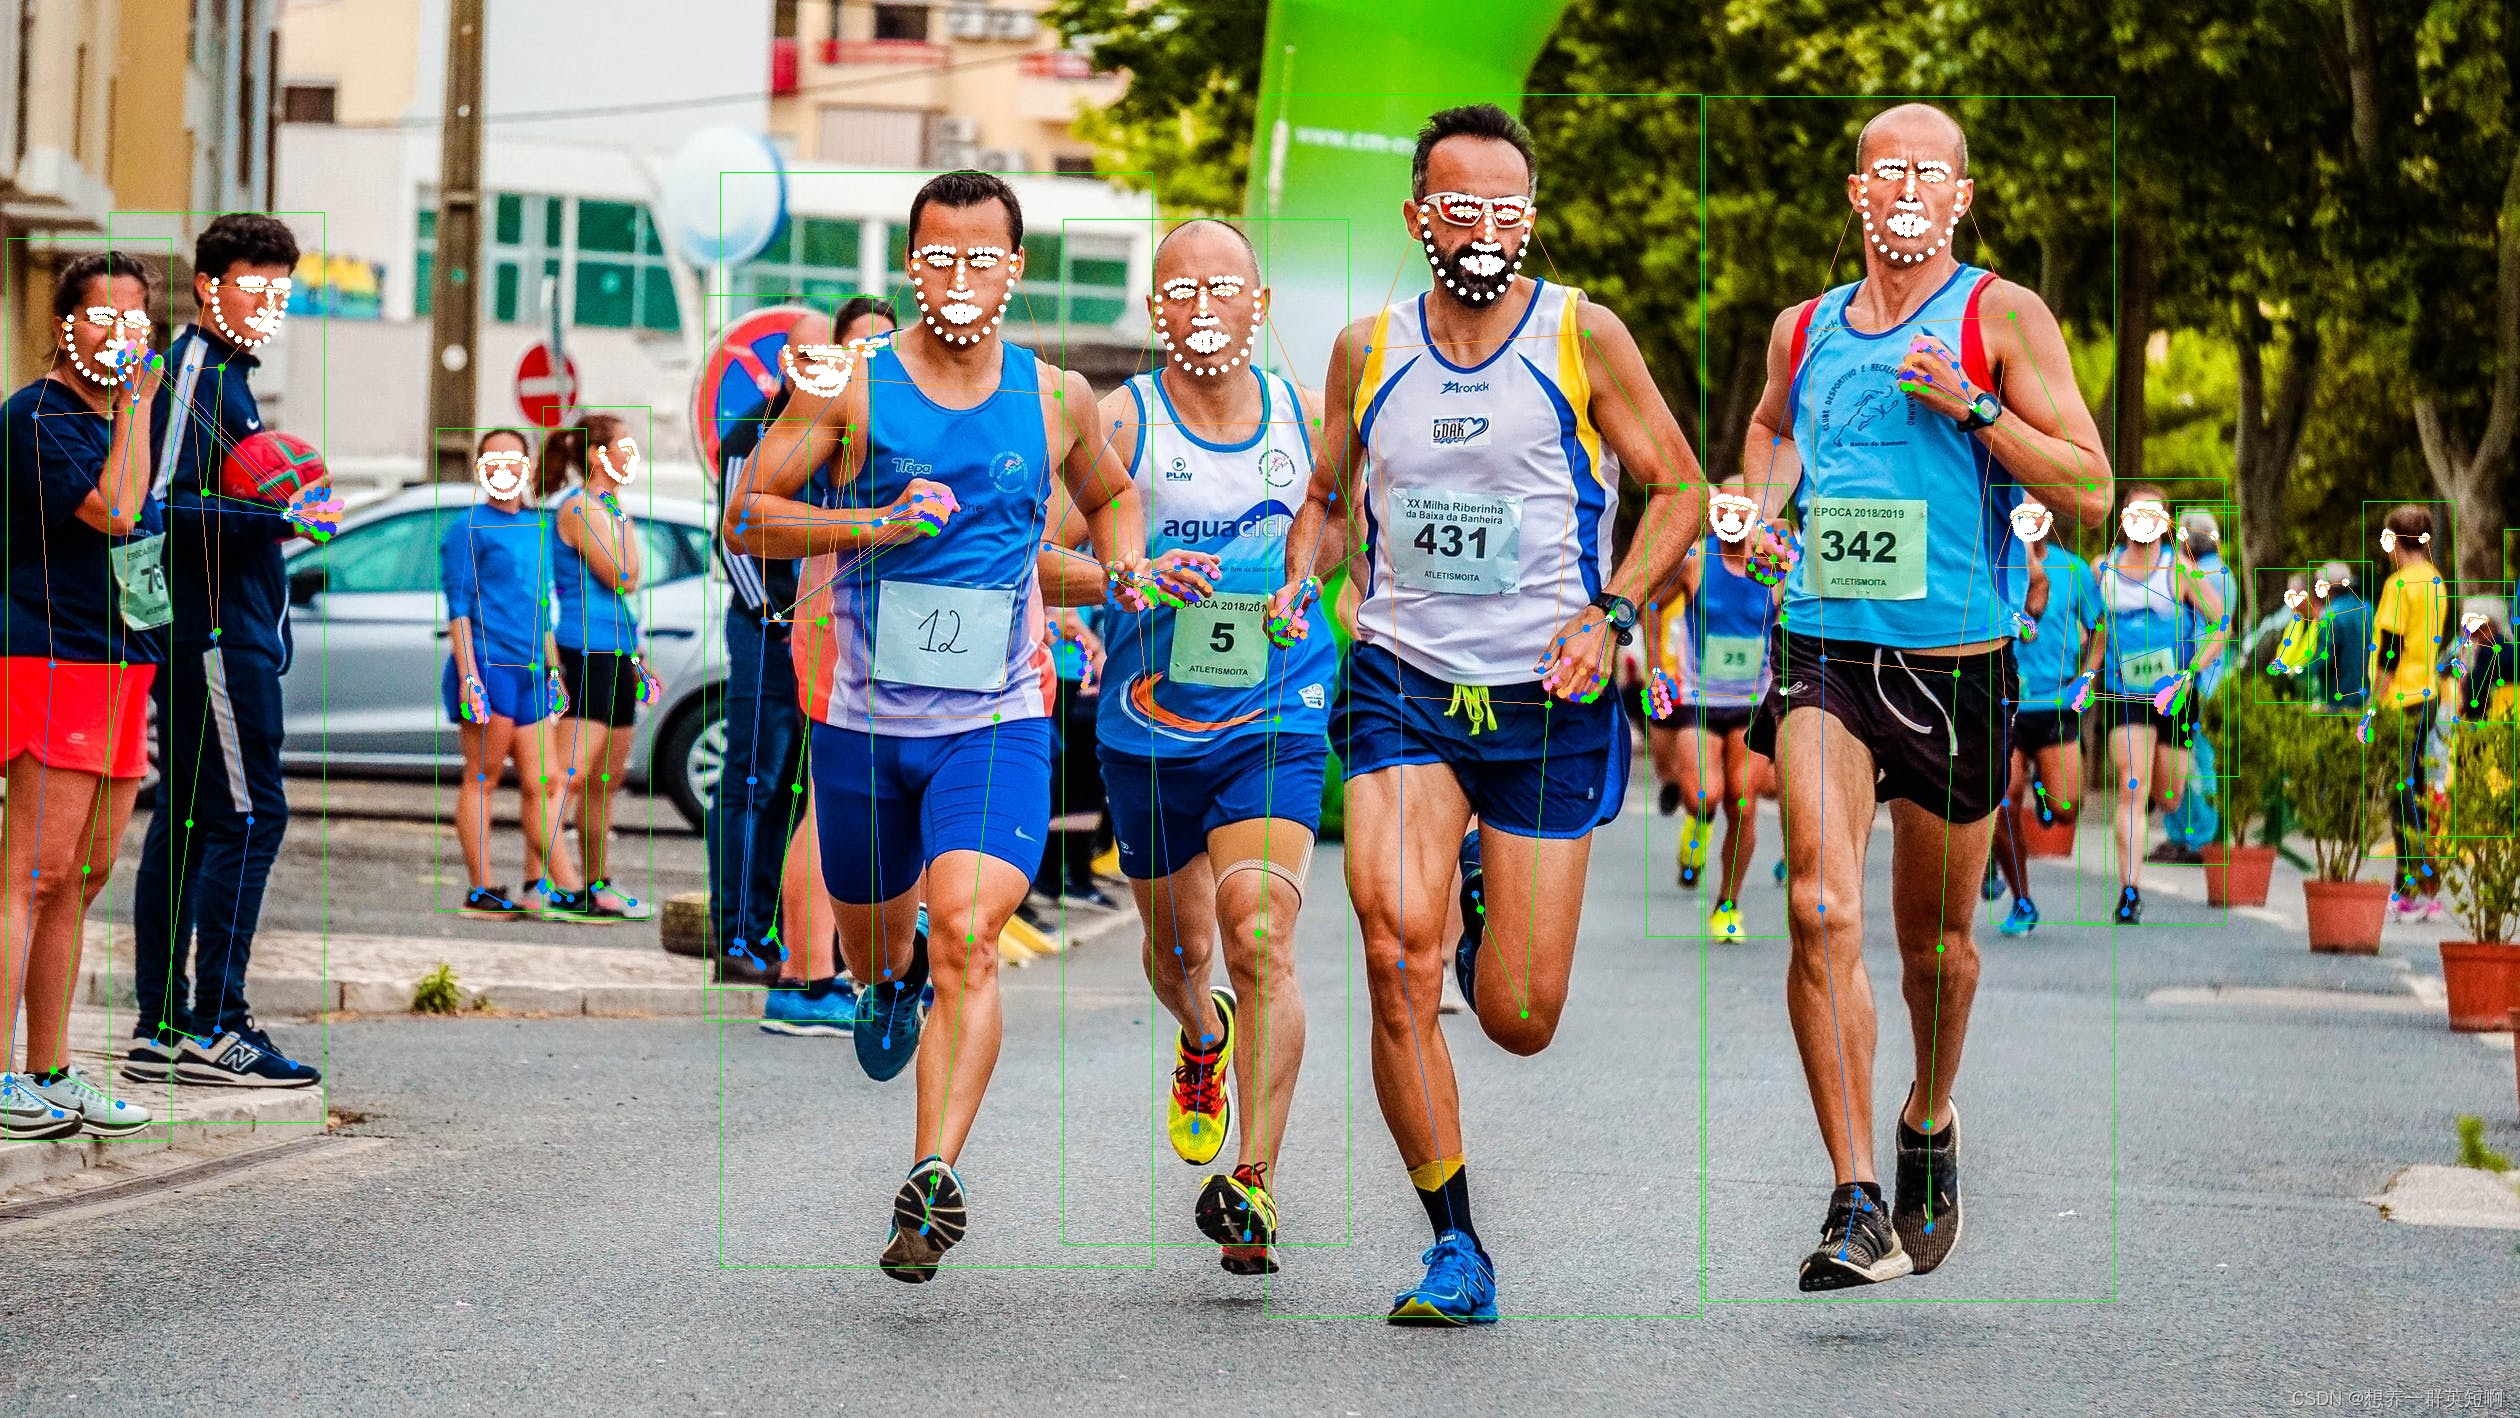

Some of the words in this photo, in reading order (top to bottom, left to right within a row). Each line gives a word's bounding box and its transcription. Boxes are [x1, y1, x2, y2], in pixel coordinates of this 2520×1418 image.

[1825, 368, 1857, 405] DESPORTIVO
[1407, 499, 1420, 509] XX
[1422, 500, 1449, 511] Milha
[1453, 502, 1504, 515] Riberinha
[1854, 508, 1905, 518] 2018/2019
[1406, 509, 1417, 518] da
[1419, 511, 1444, 521] Baixa
[1446, 512, 1458, 521] da
[1460, 513, 1503, 525] Banheira
[1413, 523, 1487, 559] 431
[1820, 530, 1897, 563] 342
[1424, 570, 1480, 582] ATLETISMOITA
[1830, 578, 1887, 587] ATLETISMOITA
[918, 608, 968, 654] 12
[1209, 622, 1235, 653] 5
[1189, 665, 1249, 676] ATLETISMOITA
